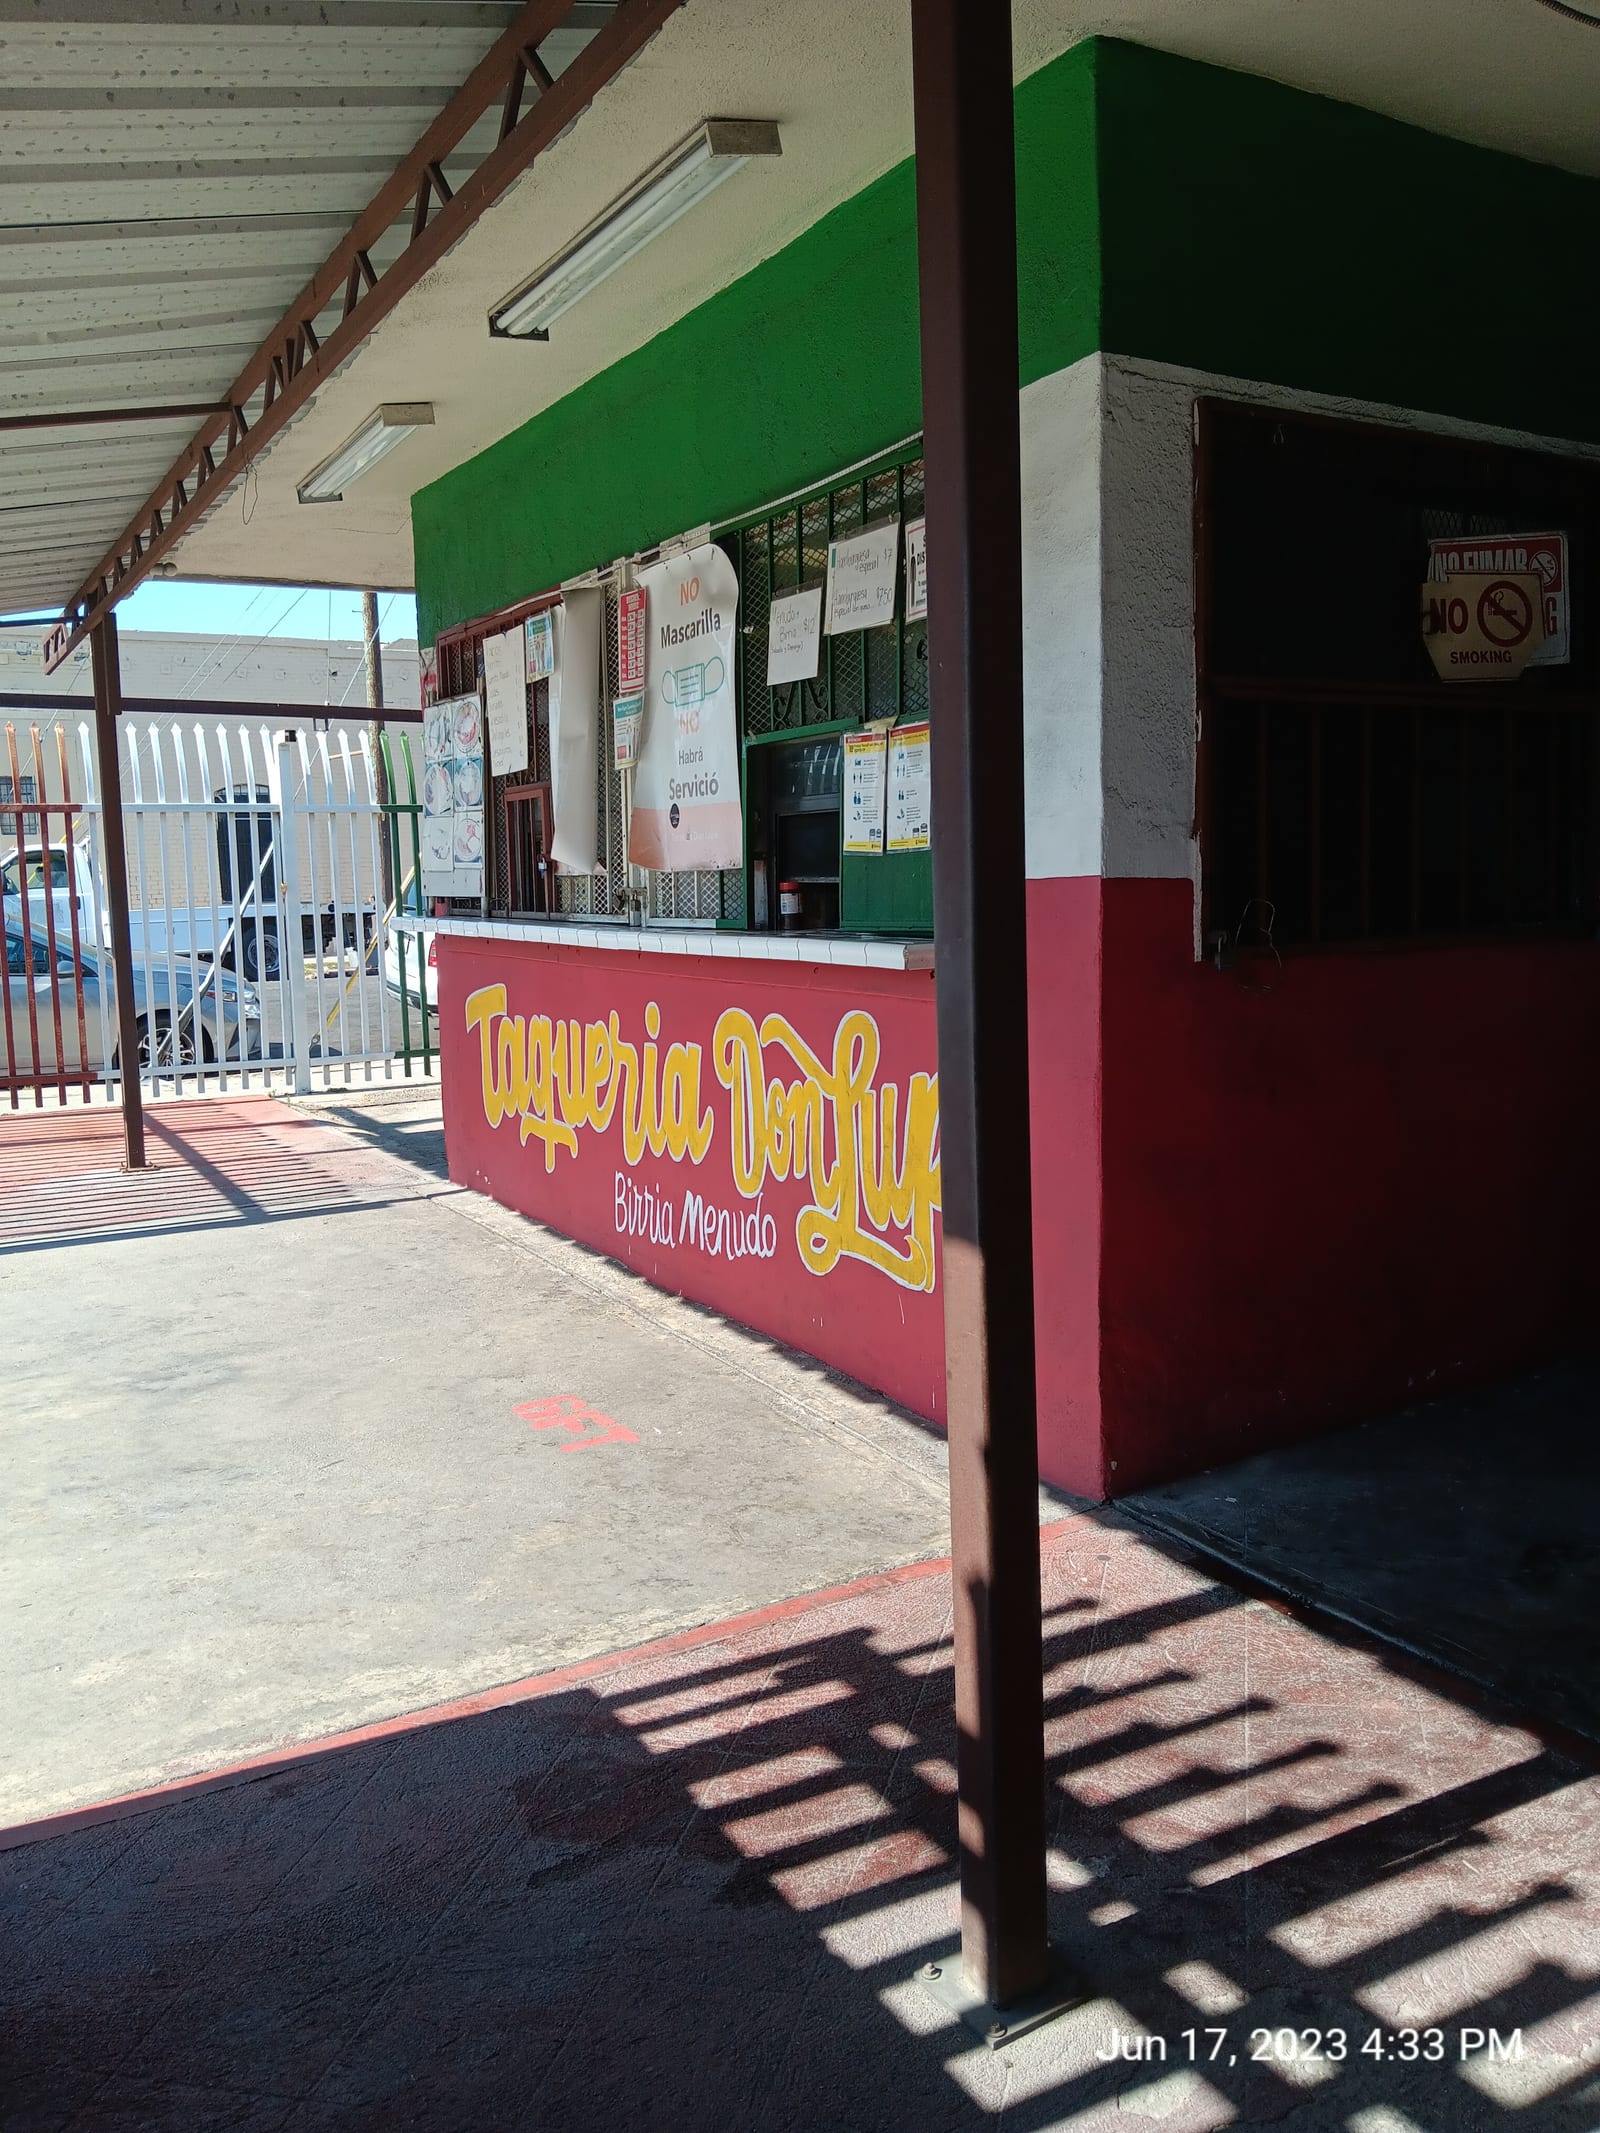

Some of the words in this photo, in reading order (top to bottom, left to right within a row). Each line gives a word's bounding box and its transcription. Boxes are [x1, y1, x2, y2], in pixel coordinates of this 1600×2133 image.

[680, 577, 700, 606] NO
[660, 607, 721, 649] Mascarilla
[1427, 598, 1468, 635] NO
[1450, 649, 1512, 664] SMOKING
[678, 747, 704, 766] Habrá
[669, 772, 720, 801] Servició
[465, 982, 716, 1176] Taqueria
[712, 1007, 840, 1201] Don
[796, 1009, 943, 1294] Lup
[613, 1170, 675, 1250] Birria
[679, 1188, 779, 1261] Menudo
